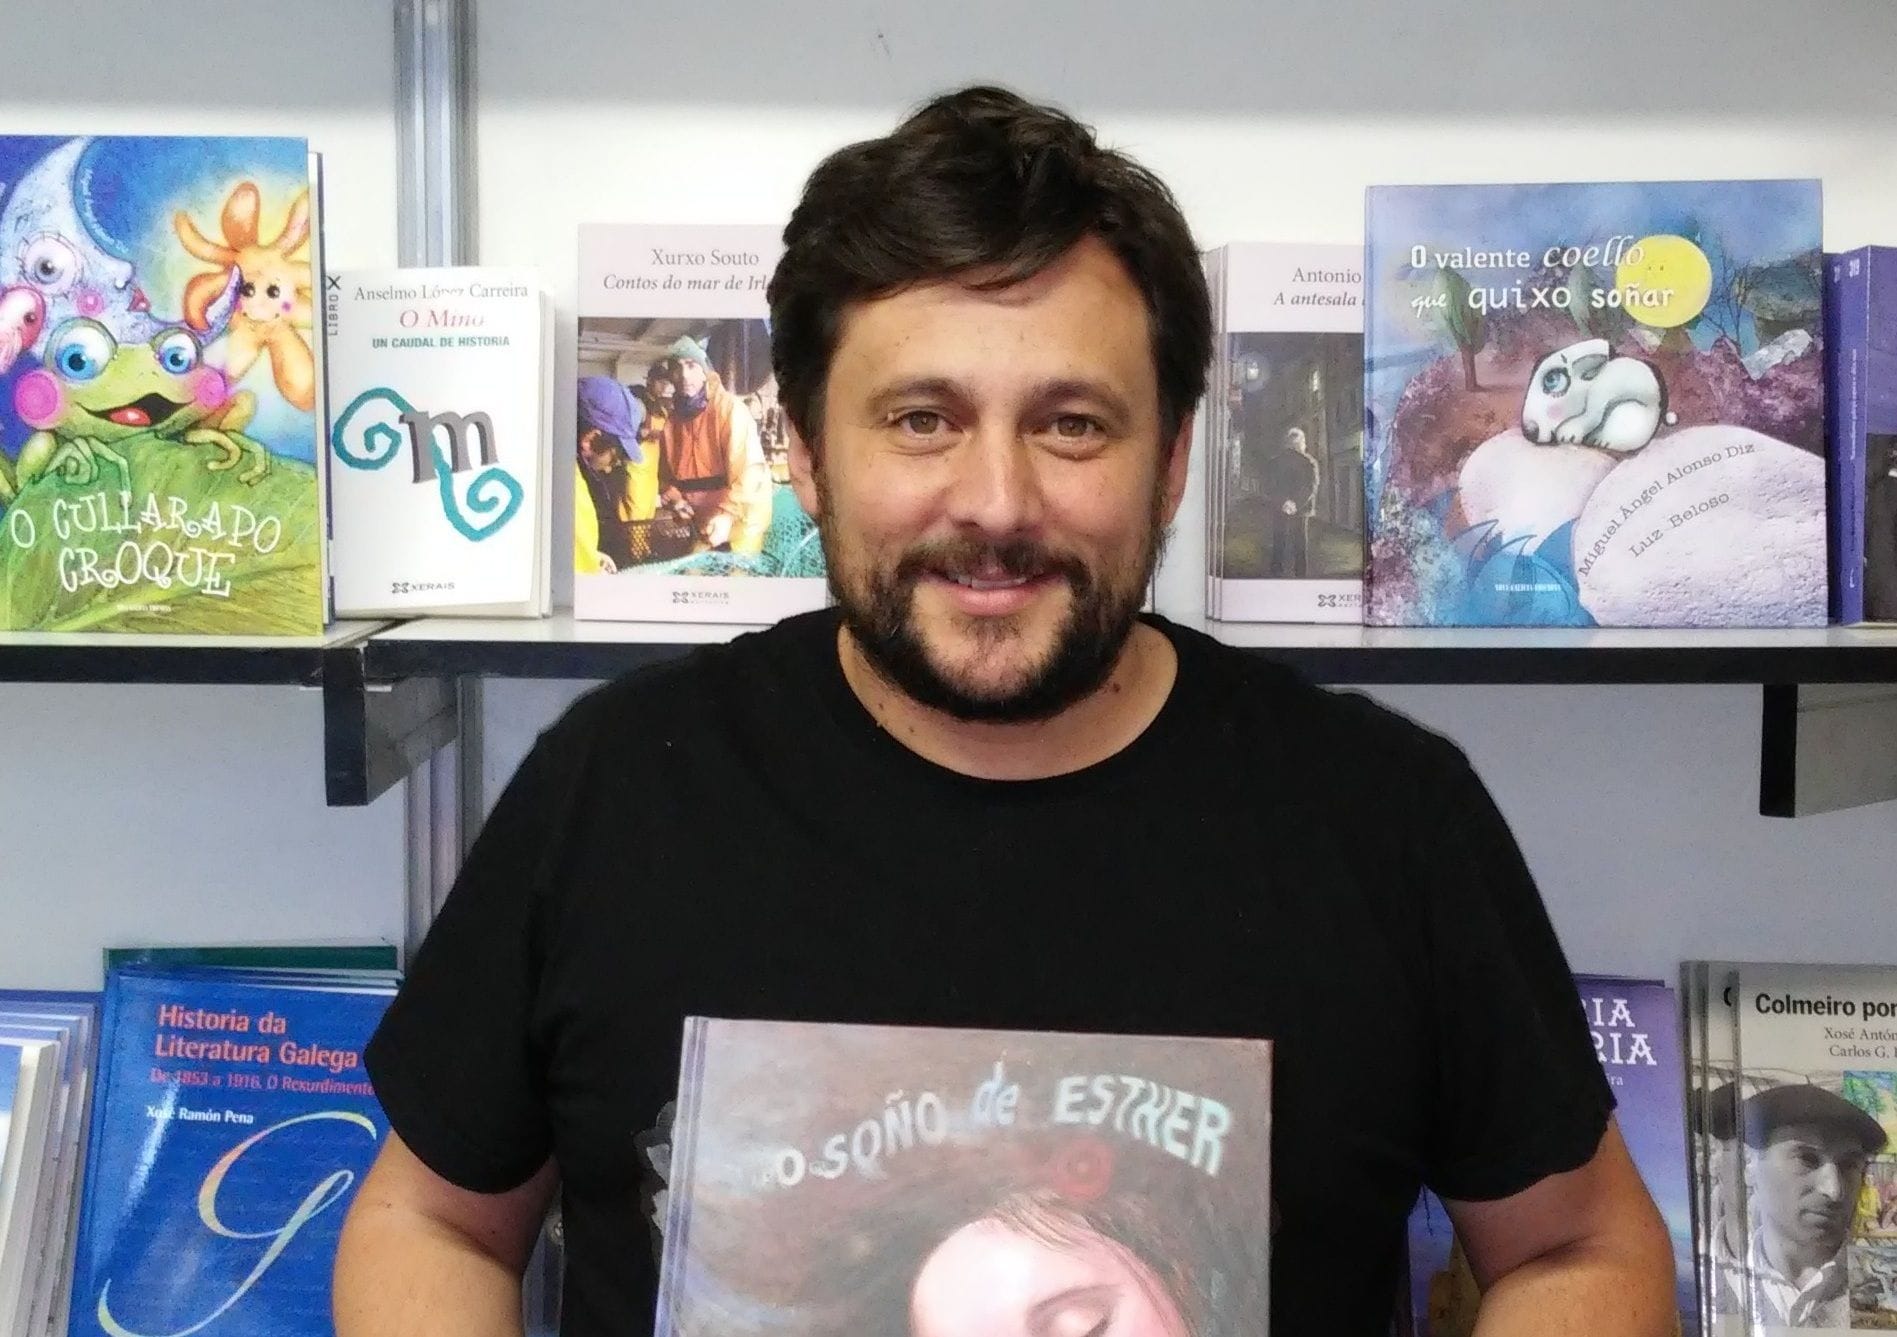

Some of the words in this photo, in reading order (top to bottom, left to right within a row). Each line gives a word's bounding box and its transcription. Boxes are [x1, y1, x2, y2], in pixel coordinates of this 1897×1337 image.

[651, 249, 705, 265] Xurxo
[711, 249, 759, 265] Souto
[1411, 245, 1427, 268] O
[1435, 247, 1530, 269] valente
[1543, 235, 1645, 268] coello
[603, 274, 658, 290] Contos
[663, 275, 682, 290] do
[687, 278, 720, 290] mar
[725, 275, 743, 290] de
[1292, 268, 1361, 283] Antonio
[354, 285, 417, 301] Anselmo
[469, 282, 528, 298] Carreira
[1273, 292, 1285, 305] A
[1290, 292, 1357, 306] antesala
[1411, 293, 1447, 317] que
[1468, 280, 1572, 316] quixo
[1591, 284, 1675, 308] soñar
[400, 309, 419, 328] O
[372, 338, 388, 349] UN
[392, 337, 434, 349] CAUDAL
[440, 337, 455, 347] DE
[458, 336, 510, 347] HISTORIA
[1578, 520, 1622, 577] Miguel
[1619, 480, 1664, 520] Ángel
[1666, 452, 1722, 484] Alonso
[1726, 443, 1756, 459] Diz
[11, 509, 36, 548] O
[53, 490, 281, 553] CULLARAPO
[1628, 528, 1664, 558] Luz
[1668, 493, 1730, 528] Beloso
[59, 541, 236, 597] CROQUE
[411, 582, 455, 592] XERAIS
[1755, 993, 1855, 1016] Colmeiro
[1863, 1001, 1897, 1021] por
[158, 1003, 249, 1032] Historia
[258, 1012, 287, 1034] da
[1824, 1027, 1854, 1040] Xosé
[154, 1033, 271, 1064] Literatura
[279, 1041, 358, 1073] Galega
[1830, 1045, 1871, 1057] Carlos
[1875, 1046, 1890, 1058] G.
[179, 1107, 221, 1122] Ramón
[224, 1110, 254, 1124] Pena
[776, 1147, 805, 1185] O
[809, 1088, 948, 1179] SOÑO
[970, 1060, 1021, 1125] de
[1053, 1073, 1232, 1177] ESTHER
